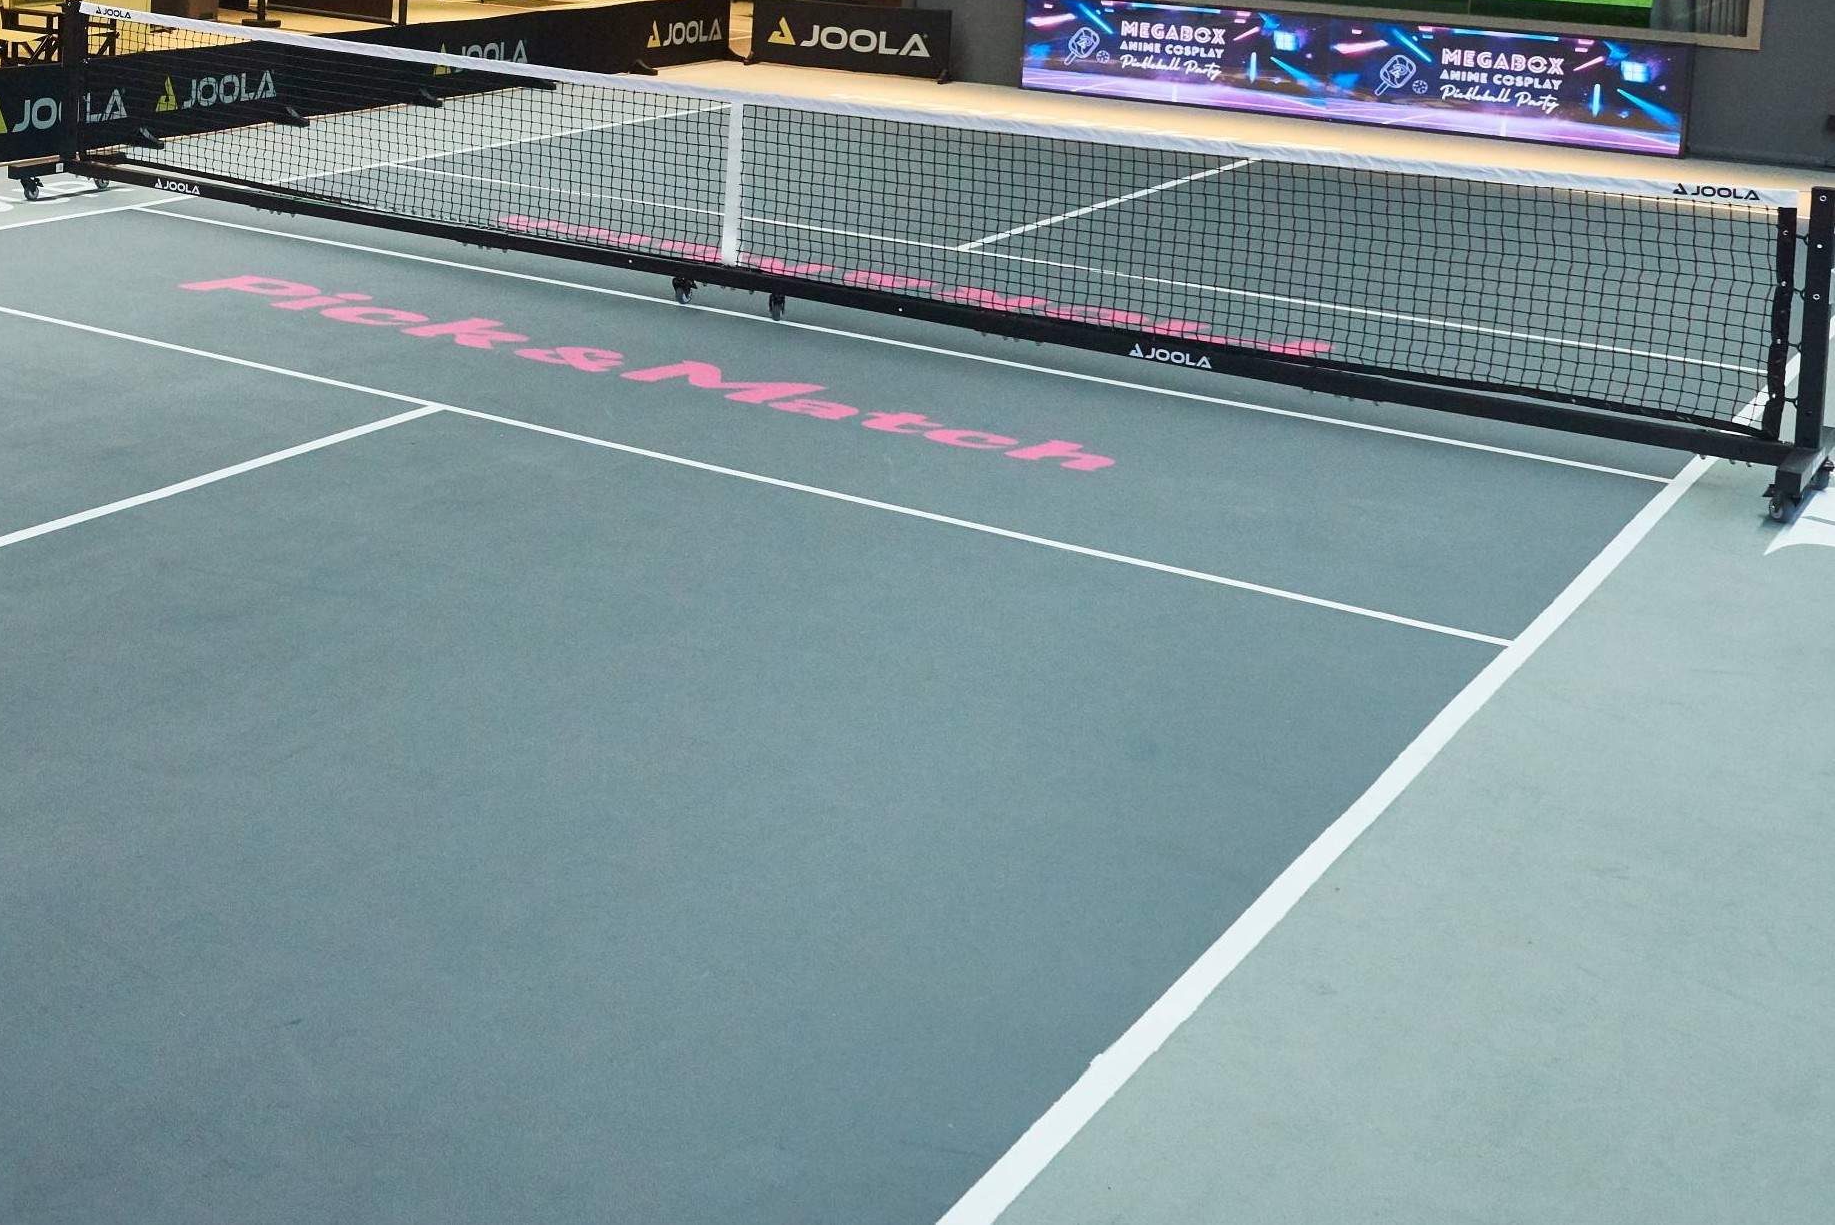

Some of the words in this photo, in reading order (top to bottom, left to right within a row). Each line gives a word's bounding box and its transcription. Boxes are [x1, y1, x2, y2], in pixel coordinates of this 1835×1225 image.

[102, 9, 132, 19] JOOLA
[663, 18, 723, 46] JOOLA
[800, 25, 931, 58] JOOLA
[1120, 20, 1226, 45] MEGABOX
[1120, 40, 1161, 54] ANIME
[1165, 43, 1224, 59] COSPLAY
[1441, 48, 1565, 75] MEGABOX
[1120, 54, 1180, 72] Pickleball
[1184, 62, 1223, 81] Party
[1440, 69, 1488, 84] ANIME
[1492, 72, 1563, 90] COSPLAY
[181, 69, 277, 110] JOOLA
[1440, 84, 1510, 104] Pickleball
[1514, 93, 1559, 114] Party
[12, 88, 127, 133] JOLA
[161, 181, 201, 195] JOOLA
[1690, 185, 1761, 201] JOOLA
[1145, 347, 1212, 369] JOOLA
